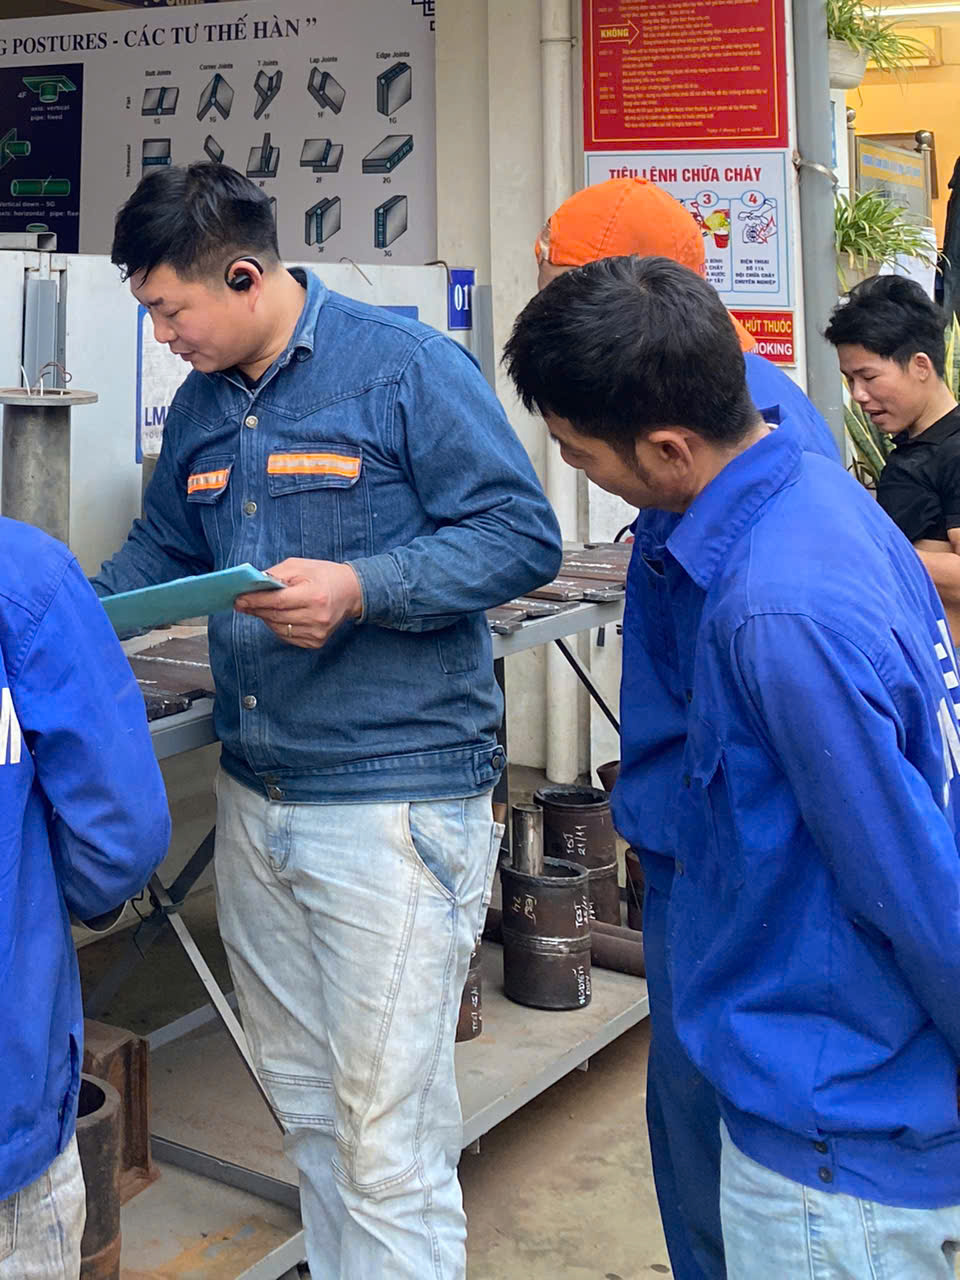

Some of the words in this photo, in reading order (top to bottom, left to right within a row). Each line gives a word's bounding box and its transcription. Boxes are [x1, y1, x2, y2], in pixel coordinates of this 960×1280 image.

[12, 31, 109, 56] POSTURES
[124, 26, 165, 48] CÁC
[170, 23, 200, 45] TƯ
[203, 13, 247, 42] THẾ
[253, 15, 300, 38] HÀN
[600, 27, 629, 38] KHÔNG
[682, 164, 720, 183] CHỮA
[724, 163, 762, 182] CHÁY
[703, 193, 712, 205] 3
[749, 193, 758, 204] 4
[454, 284, 471, 311] 01
[745, 317, 762, 332] HÚT
[763, 318, 792, 333] THUỐC
[750, 342, 793, 355] MOKING
